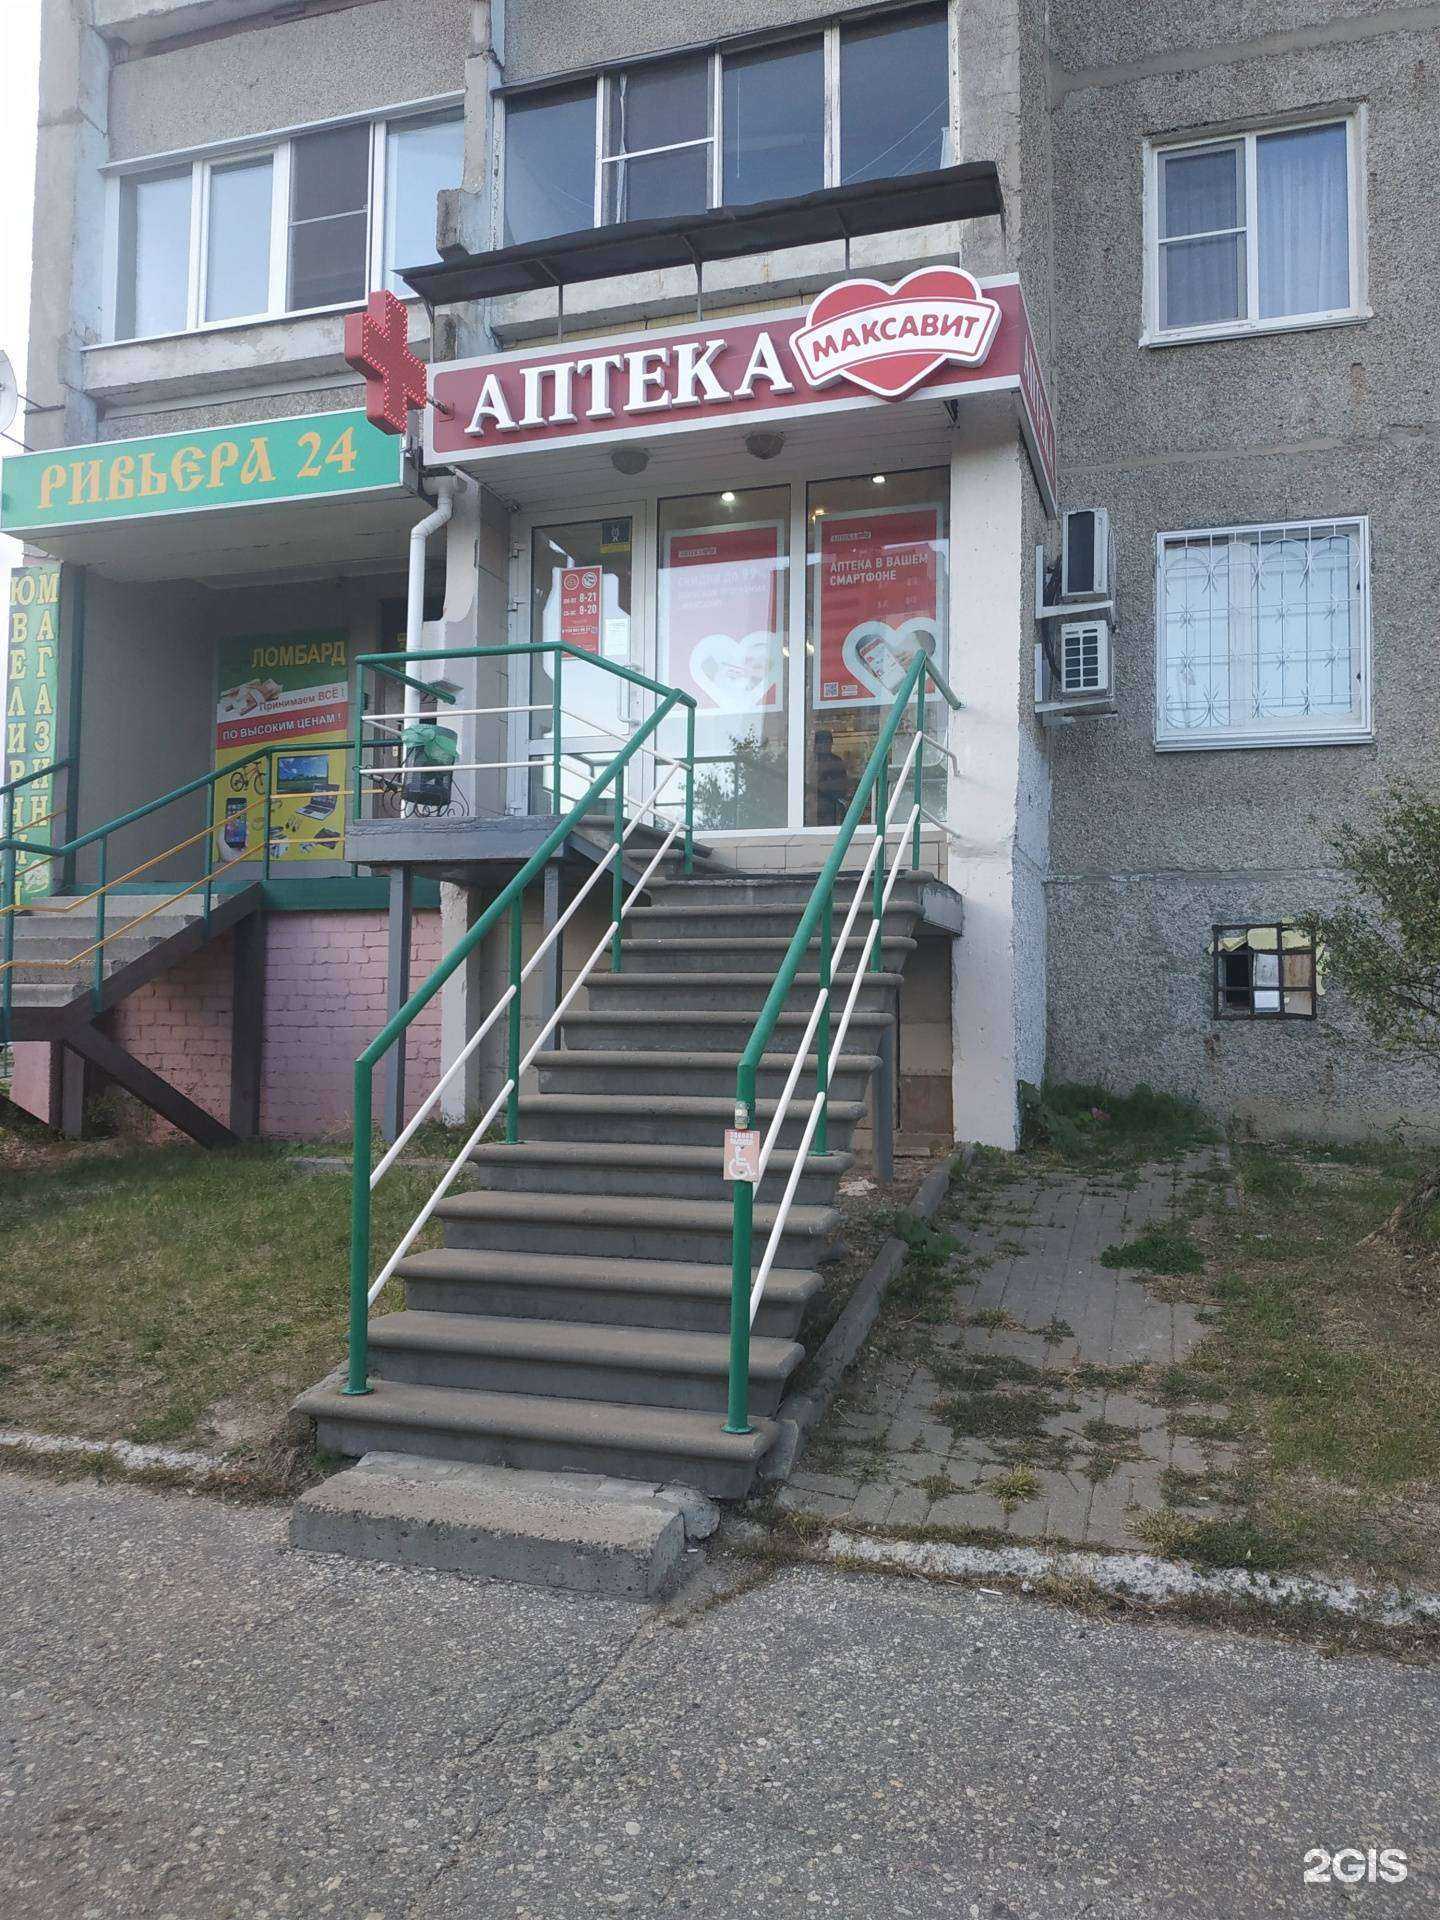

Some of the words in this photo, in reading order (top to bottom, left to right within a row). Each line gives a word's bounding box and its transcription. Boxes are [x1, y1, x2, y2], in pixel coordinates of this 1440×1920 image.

[811, 312, 981, 363] МАКСАВИТ
[464, 331, 796, 436] АПТЕКА
[37, 437, 276, 510] РИВЬЕРА
[297, 427, 357, 478] 24
[830, 559, 872, 573] АПТЕКА
[876, 558, 882, 568] В
[887, 554, 928, 567] ВАШЕМ
[830, 570, 897, 586] СМАРТФОНЕ
[579, 592, 597, 603] 8-21
[251, 641, 346, 668] ЛОМБАРД
[32, 573, 60, 827] МАГАЗИН
[259, 694, 316, 712] Принимаем
[223, 729, 238, 741] ПО
[240, 720, 297, 738] ВЫСОКИМ
